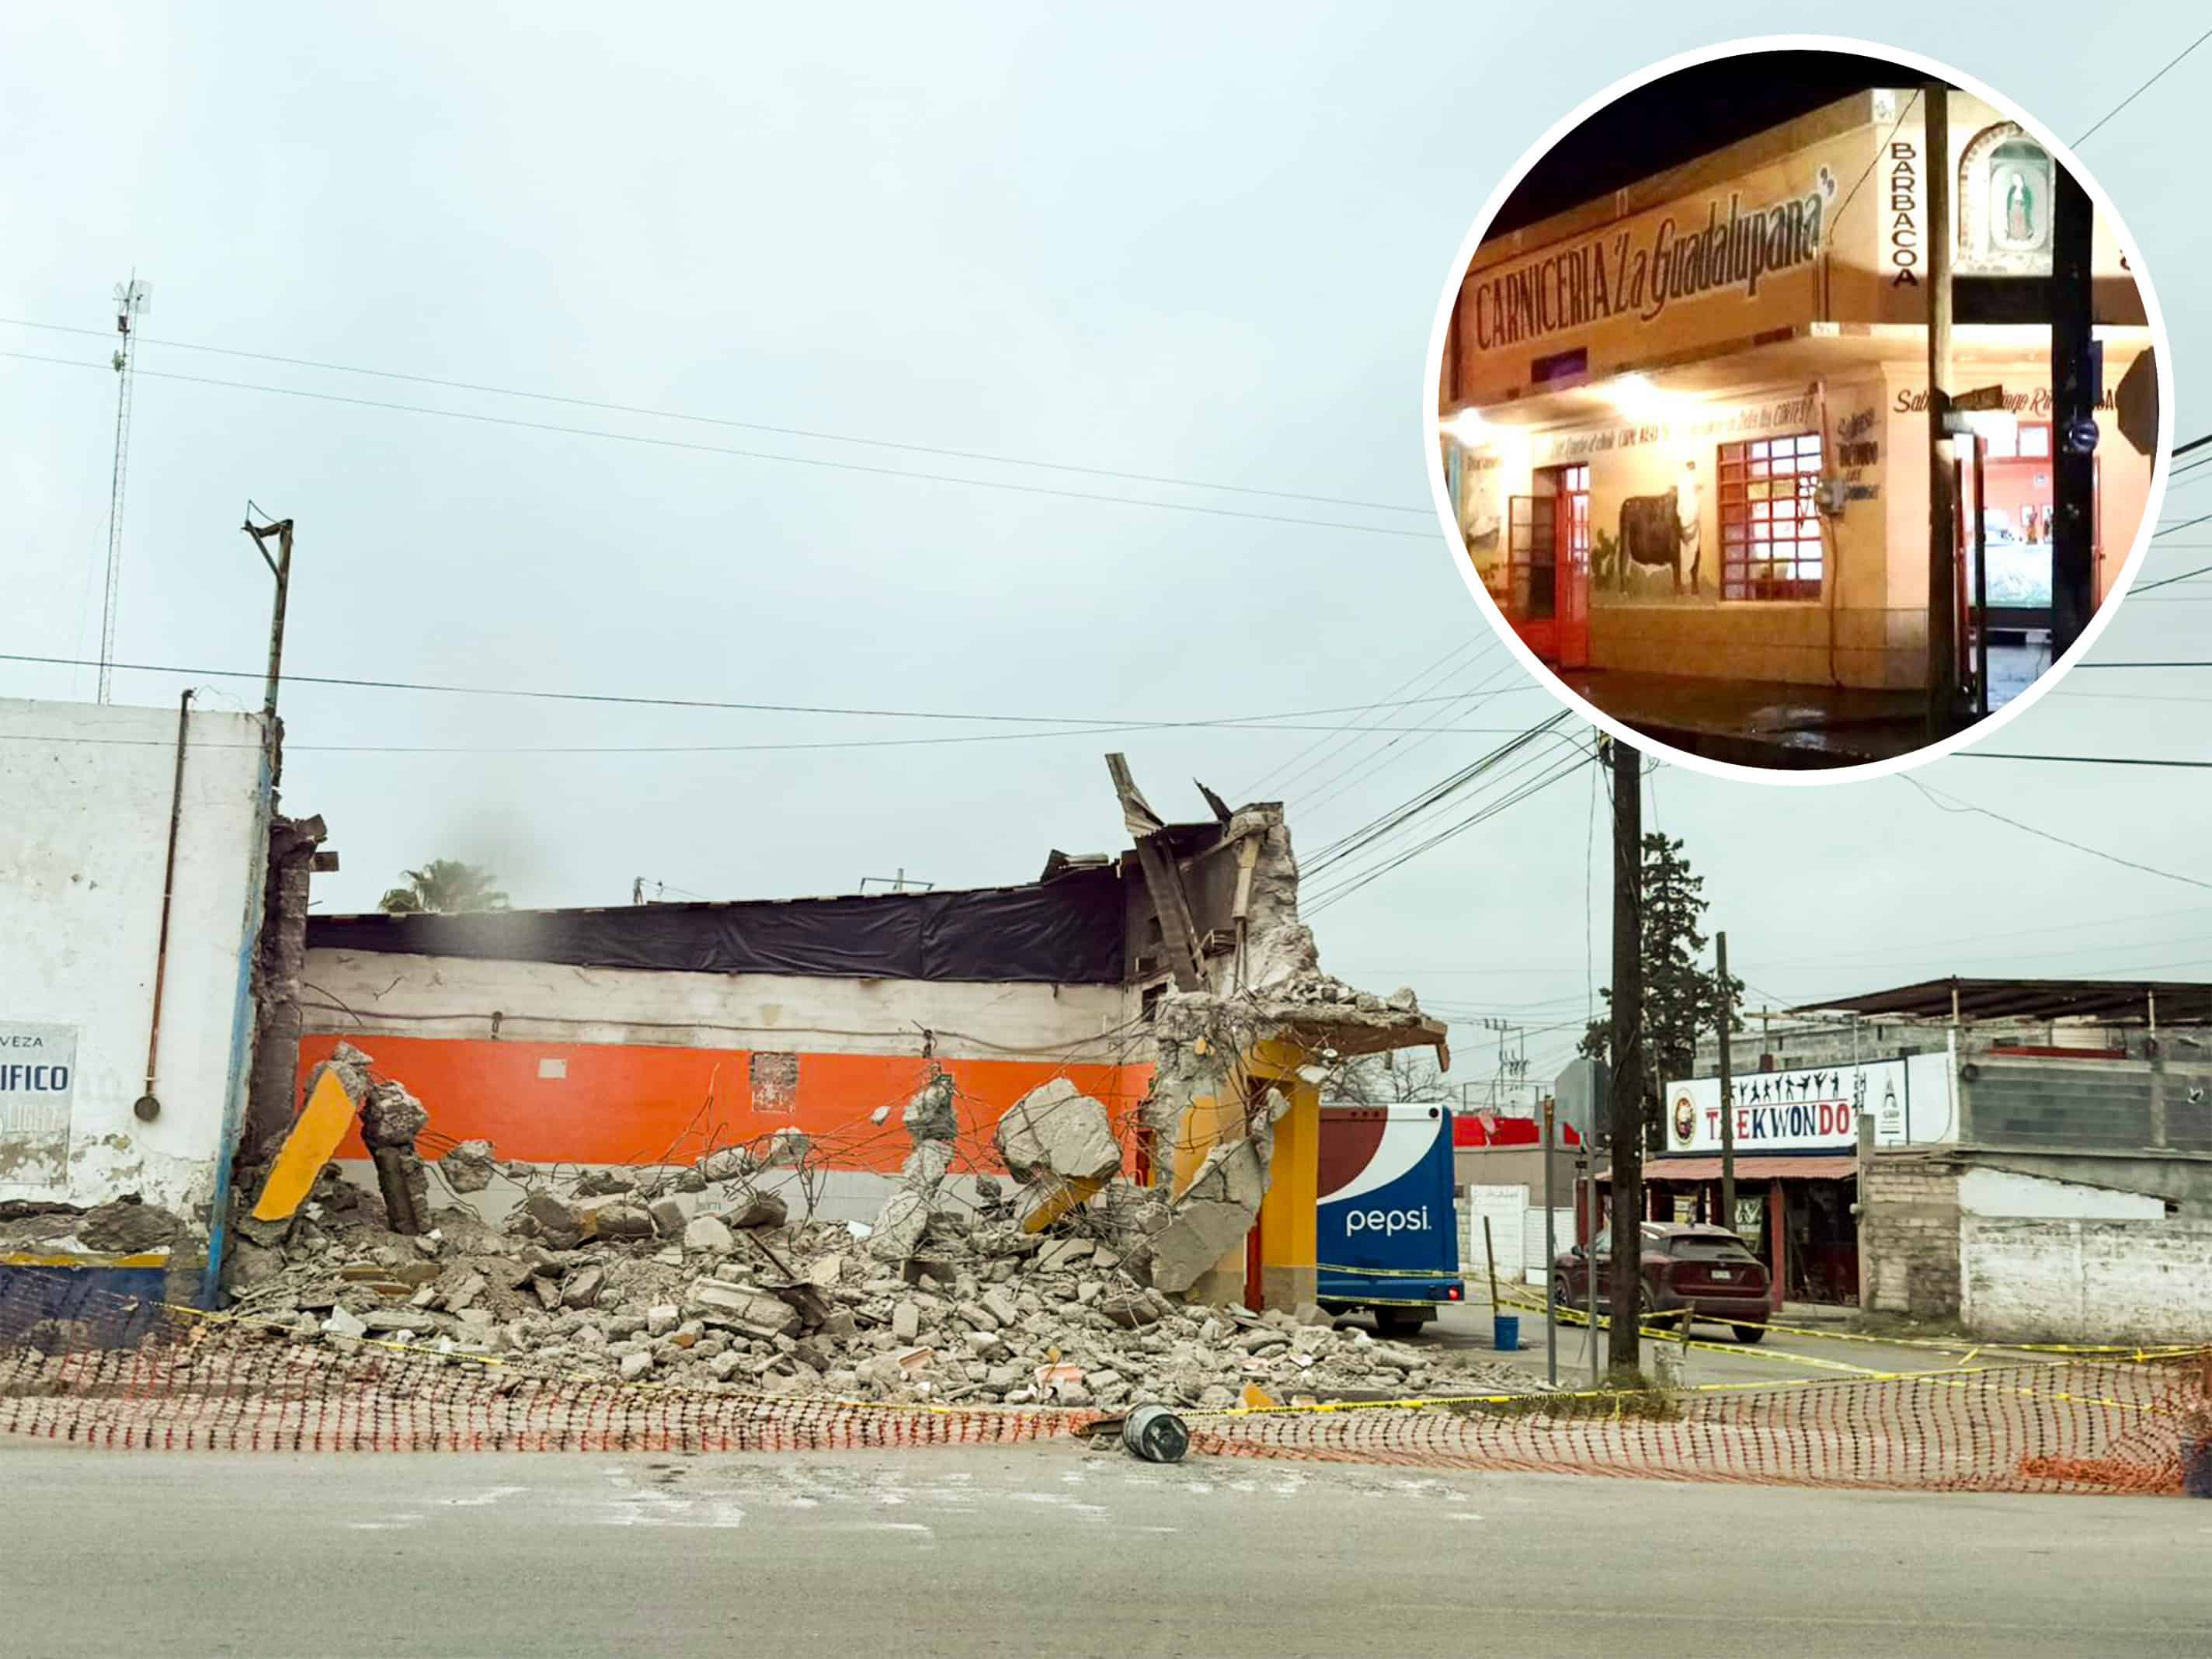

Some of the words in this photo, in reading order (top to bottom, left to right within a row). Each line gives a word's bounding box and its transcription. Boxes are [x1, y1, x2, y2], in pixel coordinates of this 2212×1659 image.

[1890, 142, 1918, 287] BARBACOA
[1476, 242, 1612, 350] CARNICERIA
[0, 1035, 43, 1048] VEZA
[1, 1064, 68, 1091] IFICO
[1705, 1103, 1850, 1140] TEKWONDO
